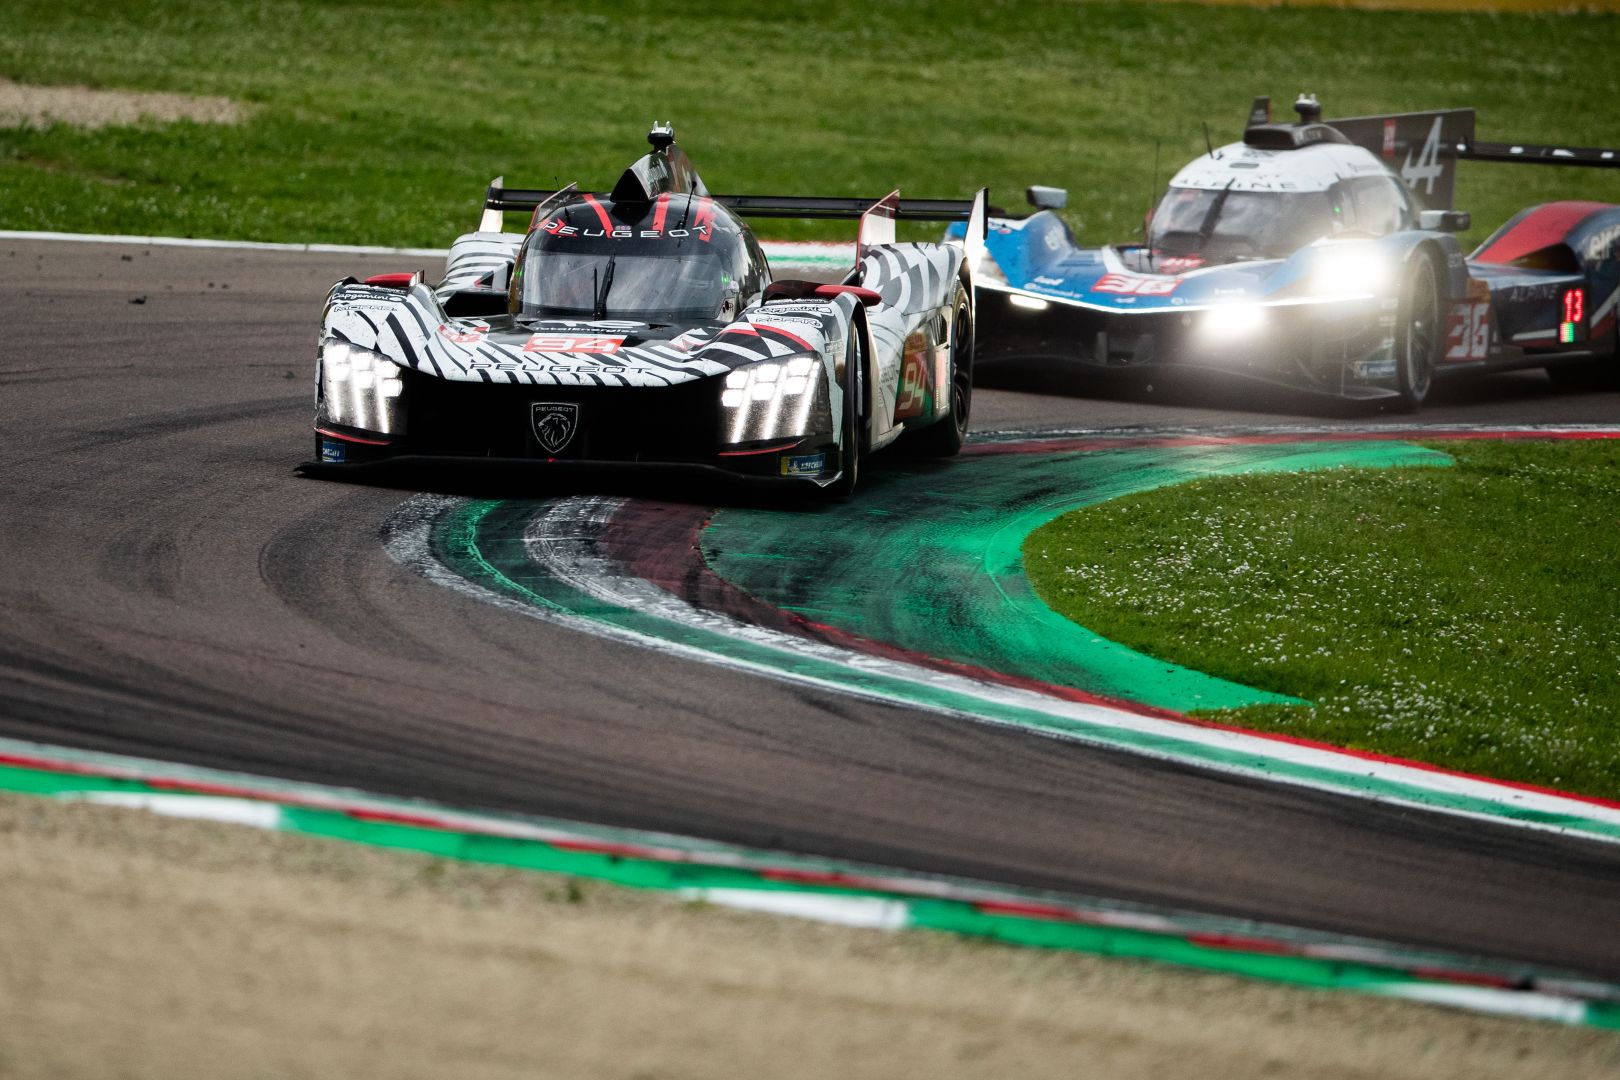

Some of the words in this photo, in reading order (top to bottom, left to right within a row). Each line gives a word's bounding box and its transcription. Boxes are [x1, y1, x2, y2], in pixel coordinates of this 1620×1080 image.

[543, 221, 708, 238] PEUGEOT
[1102, 275, 1177, 294] 36
[1564, 288, 1583, 322] 13
[1446, 303, 1490, 357] 36
[531, 338, 614, 351] 94
[470, 363, 652, 374] PEUGEOT
[899, 362, 925, 410] 94
